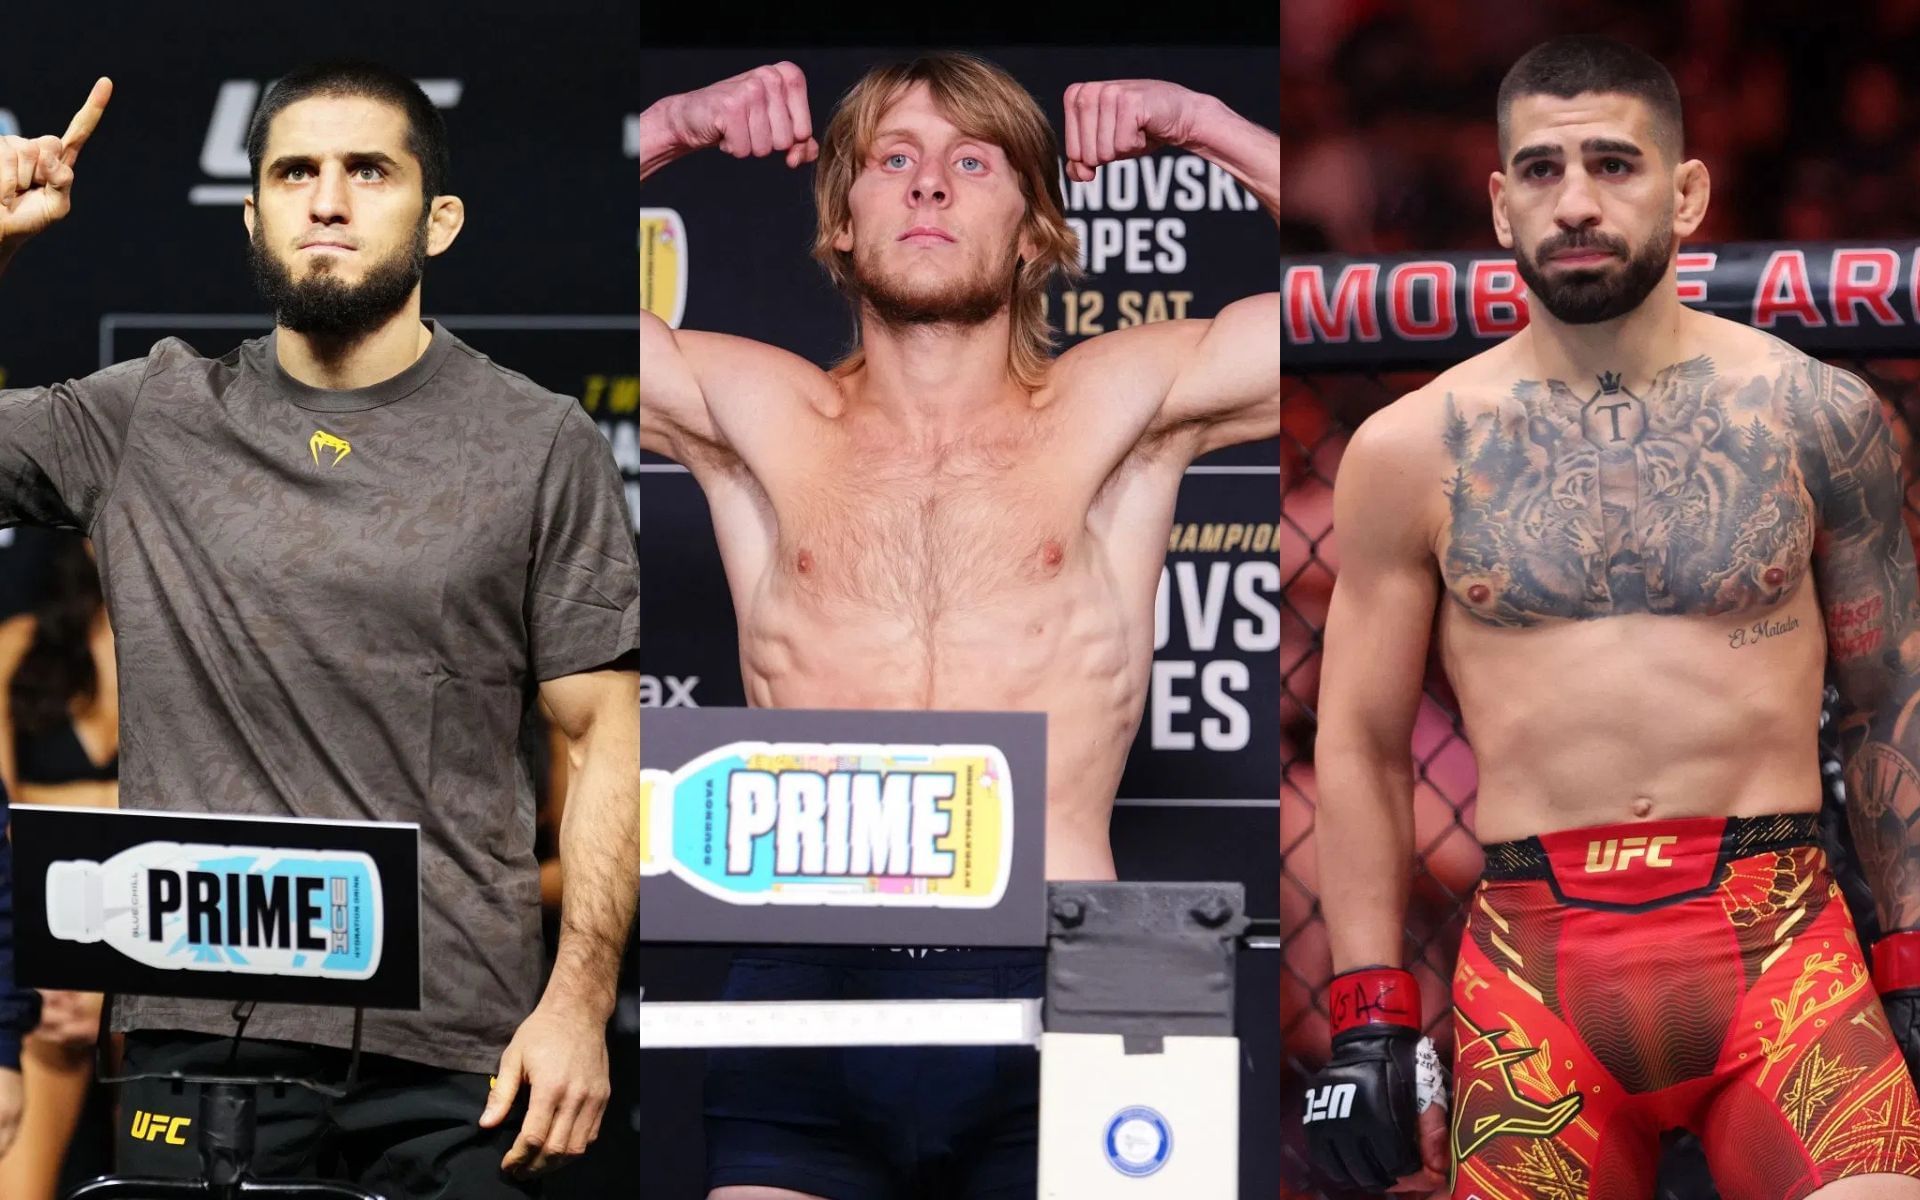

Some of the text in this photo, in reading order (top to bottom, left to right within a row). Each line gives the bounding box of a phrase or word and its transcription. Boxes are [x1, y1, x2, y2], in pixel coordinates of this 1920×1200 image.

[1753, 247, 1920, 327] AR
[1062, 290, 1104, 335] 12
[1117, 290, 1194, 330] SAT
[1728, 615, 1799, 649] El Matador
[725, 768, 956, 878] PRIME
[1584, 835, 1678, 873] UFC
[148, 868, 326, 951] PRIME
[352, 876, 360, 903] DRINK
[1302, 1083, 1357, 1125] UFC
[130, 1110, 192, 1145] UFC
